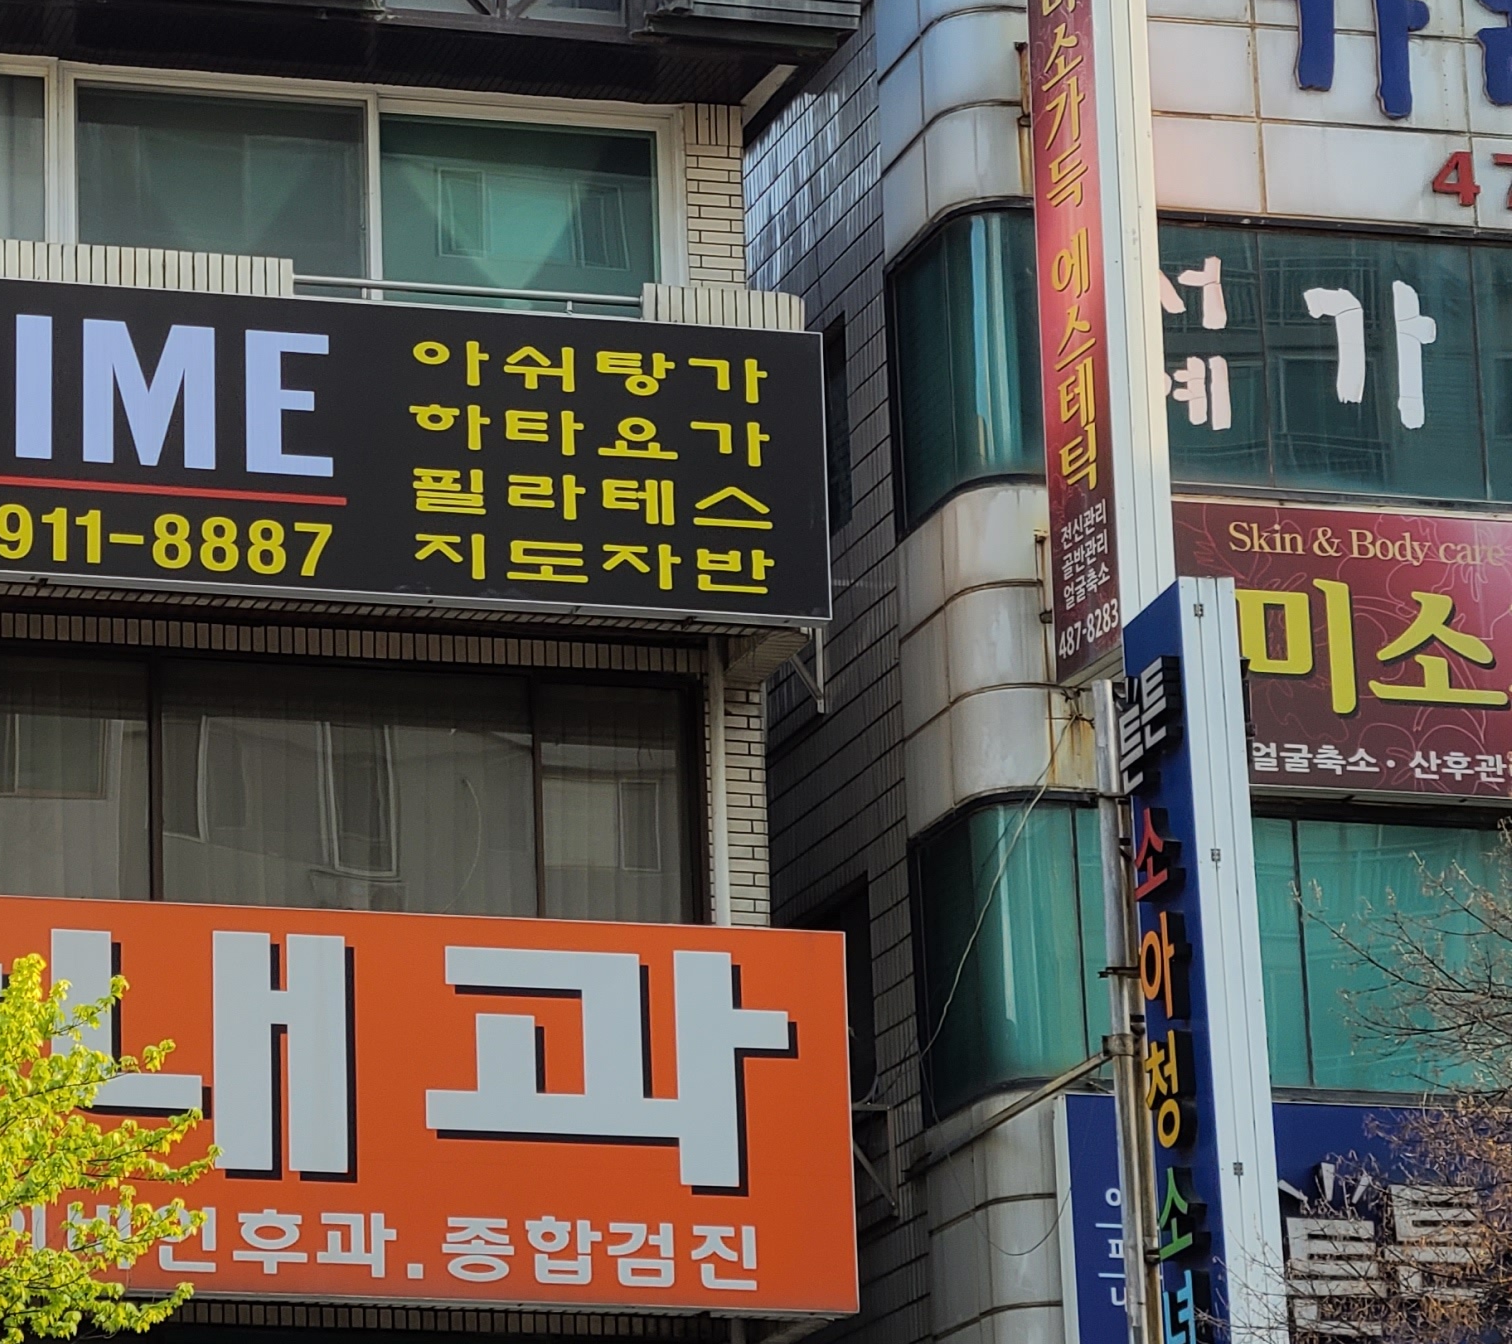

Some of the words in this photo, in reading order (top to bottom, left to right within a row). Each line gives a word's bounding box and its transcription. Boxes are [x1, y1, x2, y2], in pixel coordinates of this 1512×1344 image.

[412, 339, 769, 406] 아쉬탕가
[1048, 224, 1099, 491] 에스테틱
[408, 402, 771, 469] 하타요가
[412, 468, 774, 531] 필라테스
[1060, 499, 1108, 551] 전신관리
[414, 532, 775, 596] 지도자반
[1228, 520, 1306, 555] Skin
[1312, 526, 1344, 558] &
[1350, 529, 1432, 567] Body
[1438, 539, 1504, 567] care
[1062, 563, 1111, 610] 얼굴축소
[1058, 597, 1120, 660] 487-8283
[441, 1214, 759, 1293] 종합검진
